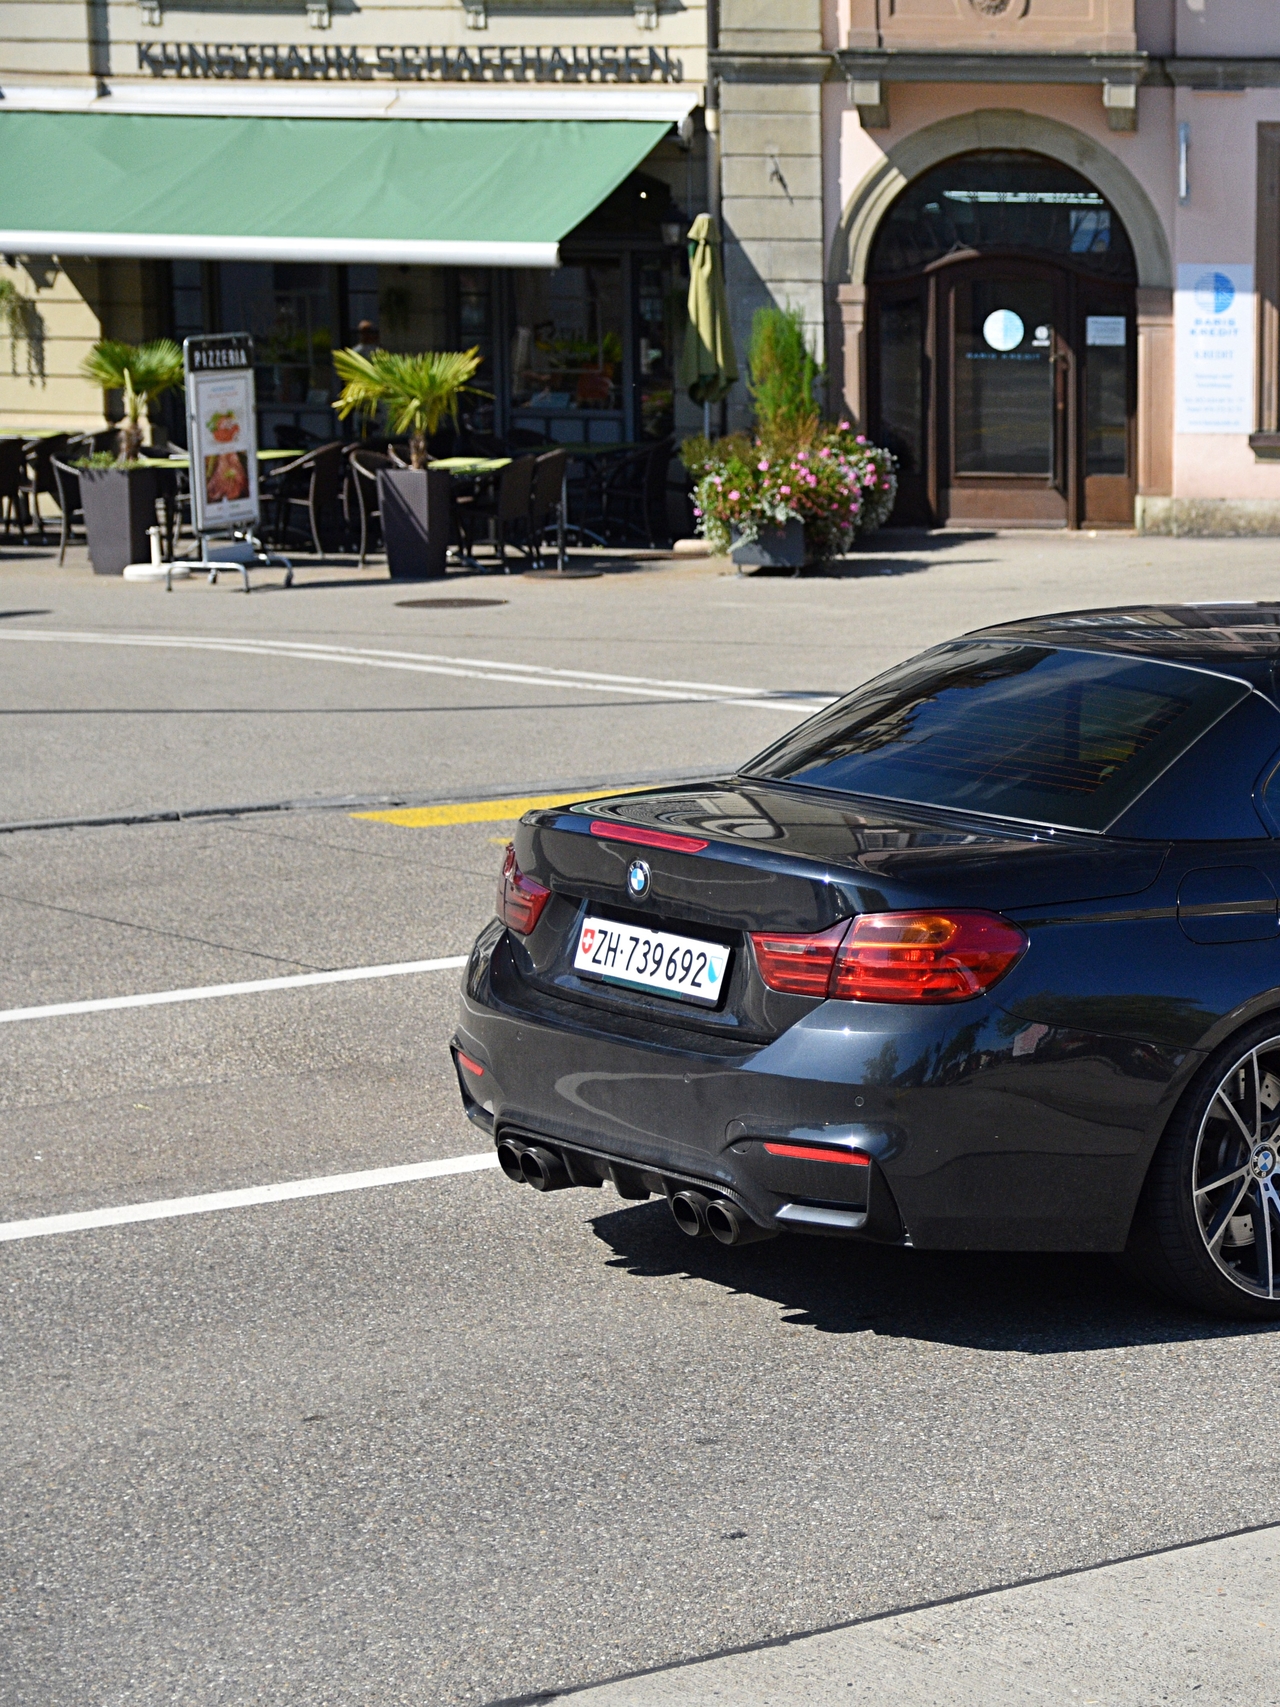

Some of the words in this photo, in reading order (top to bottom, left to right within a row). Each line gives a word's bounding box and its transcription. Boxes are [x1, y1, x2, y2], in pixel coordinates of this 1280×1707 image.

[137, 43, 359, 79] KUNSTRAUM
[376, 45, 676, 81] SCHAFFHAUSEN
[193, 348, 248, 369] PIZZERIA
